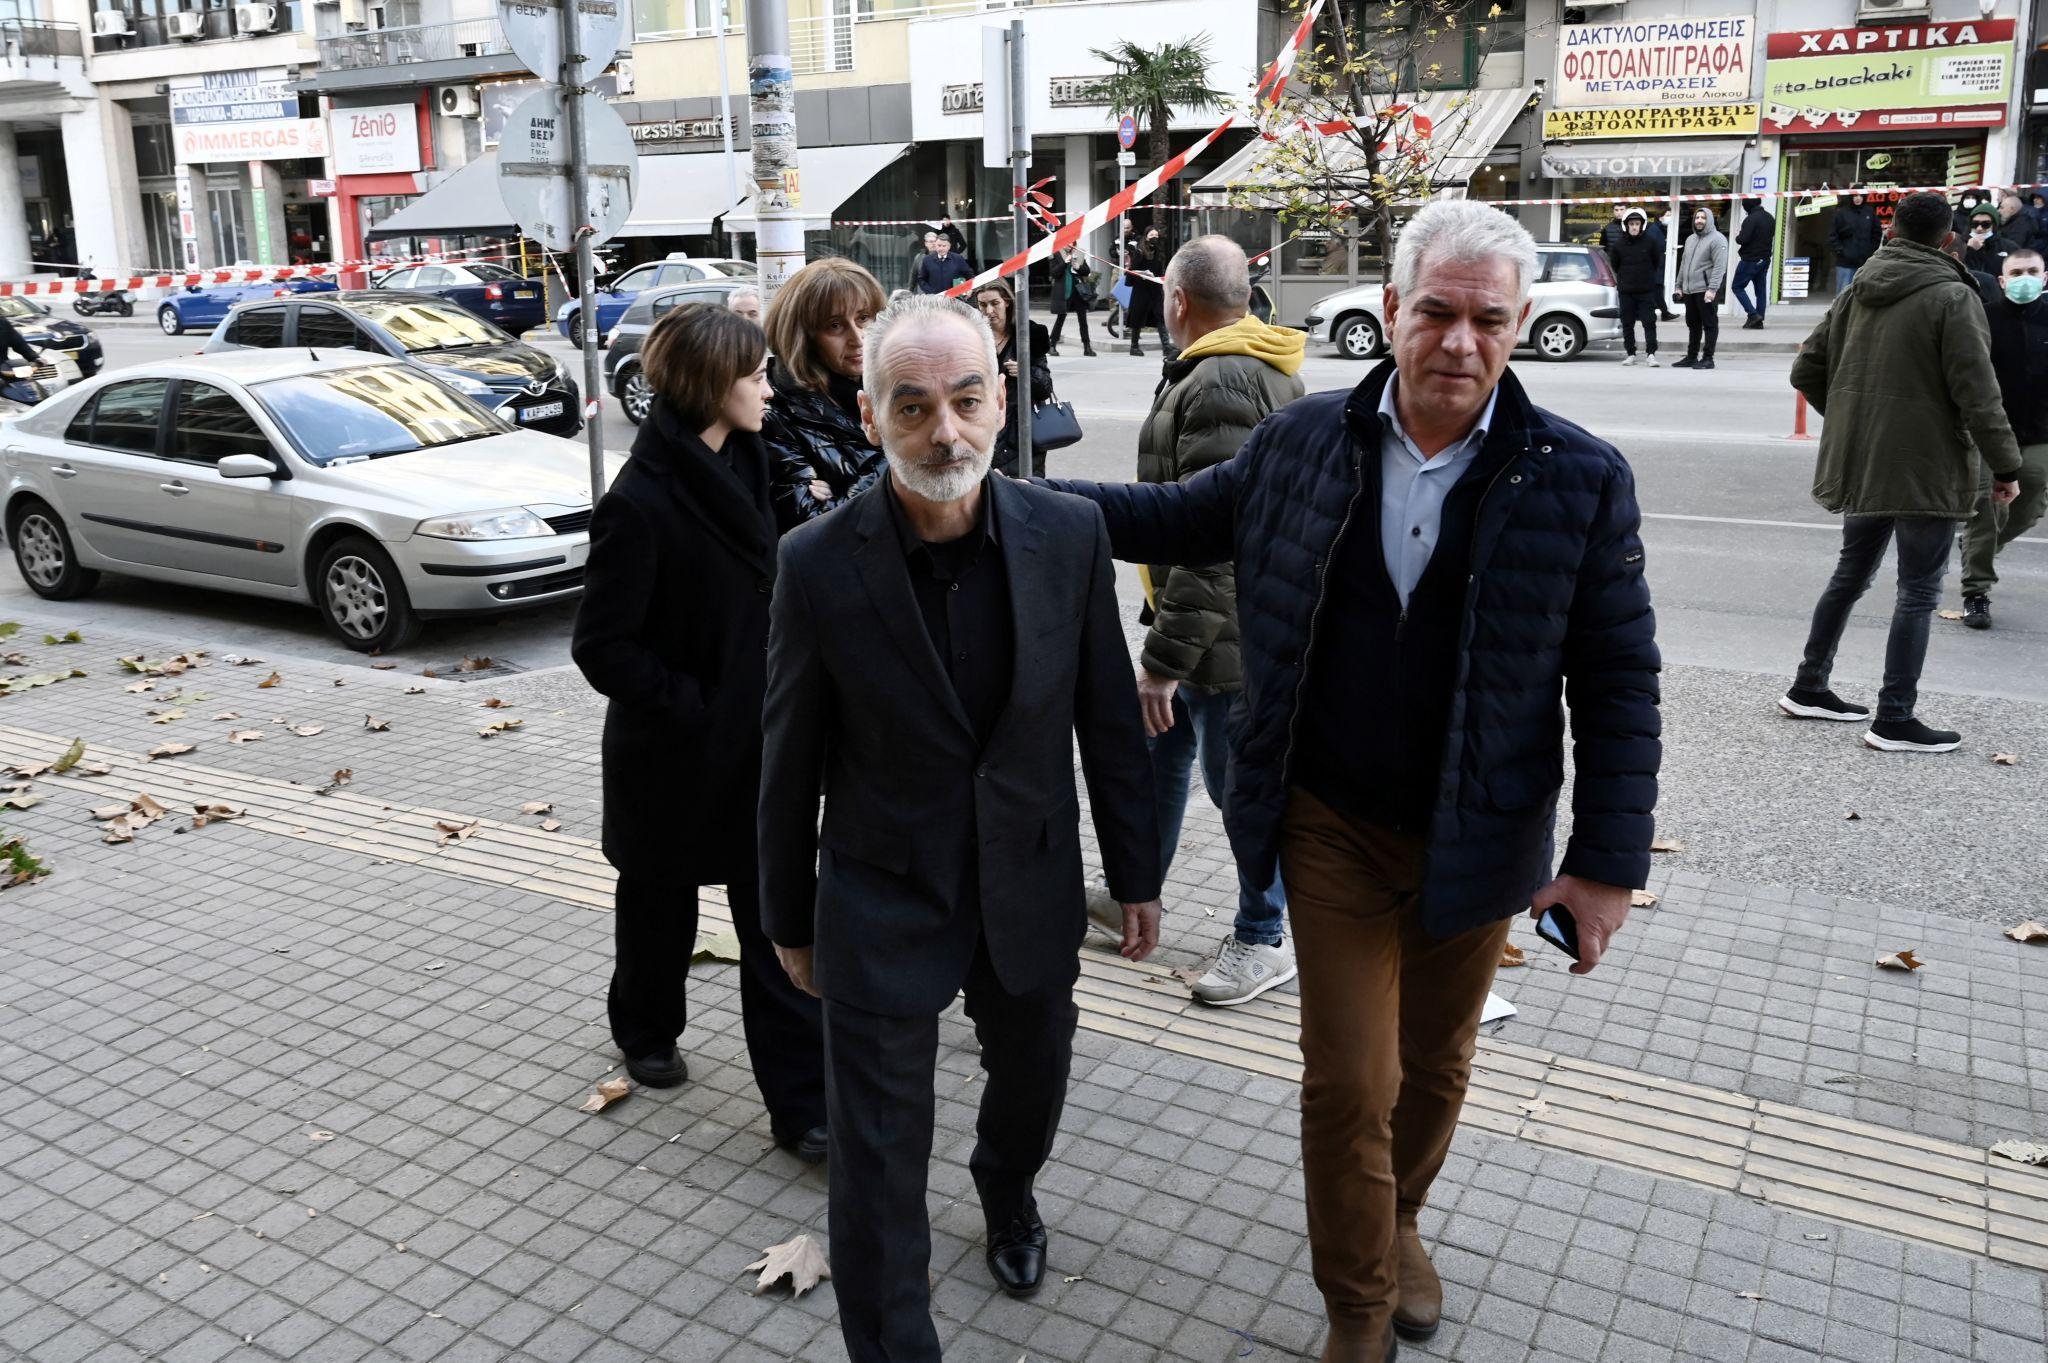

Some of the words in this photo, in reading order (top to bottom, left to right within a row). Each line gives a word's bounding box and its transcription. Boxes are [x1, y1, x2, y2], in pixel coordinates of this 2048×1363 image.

[1567, 19, 1746, 46] ΔΑΚΤΥΛΟΓΡΑΦΗΣΕΙΣ
[1798, 24, 1979, 53] ΧΑΡΤΙΚΑ
[1563, 42, 1744, 82] ΦΩΤΟΑΝΤΙΓΡΑΦΑ
[1586, 77, 1718, 93] ΜΕΤΑΦΡΑΣΕΙΣ
[1548, 104, 1756, 122] ΔΑΚΤΥΛΟΓΡΑΦΗΣΕΙΣ
[1564, 116, 1737, 132] ΦΩΤΟΑΝΤΙΓΡΑΦΑ
[198, 128, 300, 151] IMMERGAS
[630, 118, 686, 139] nessis
